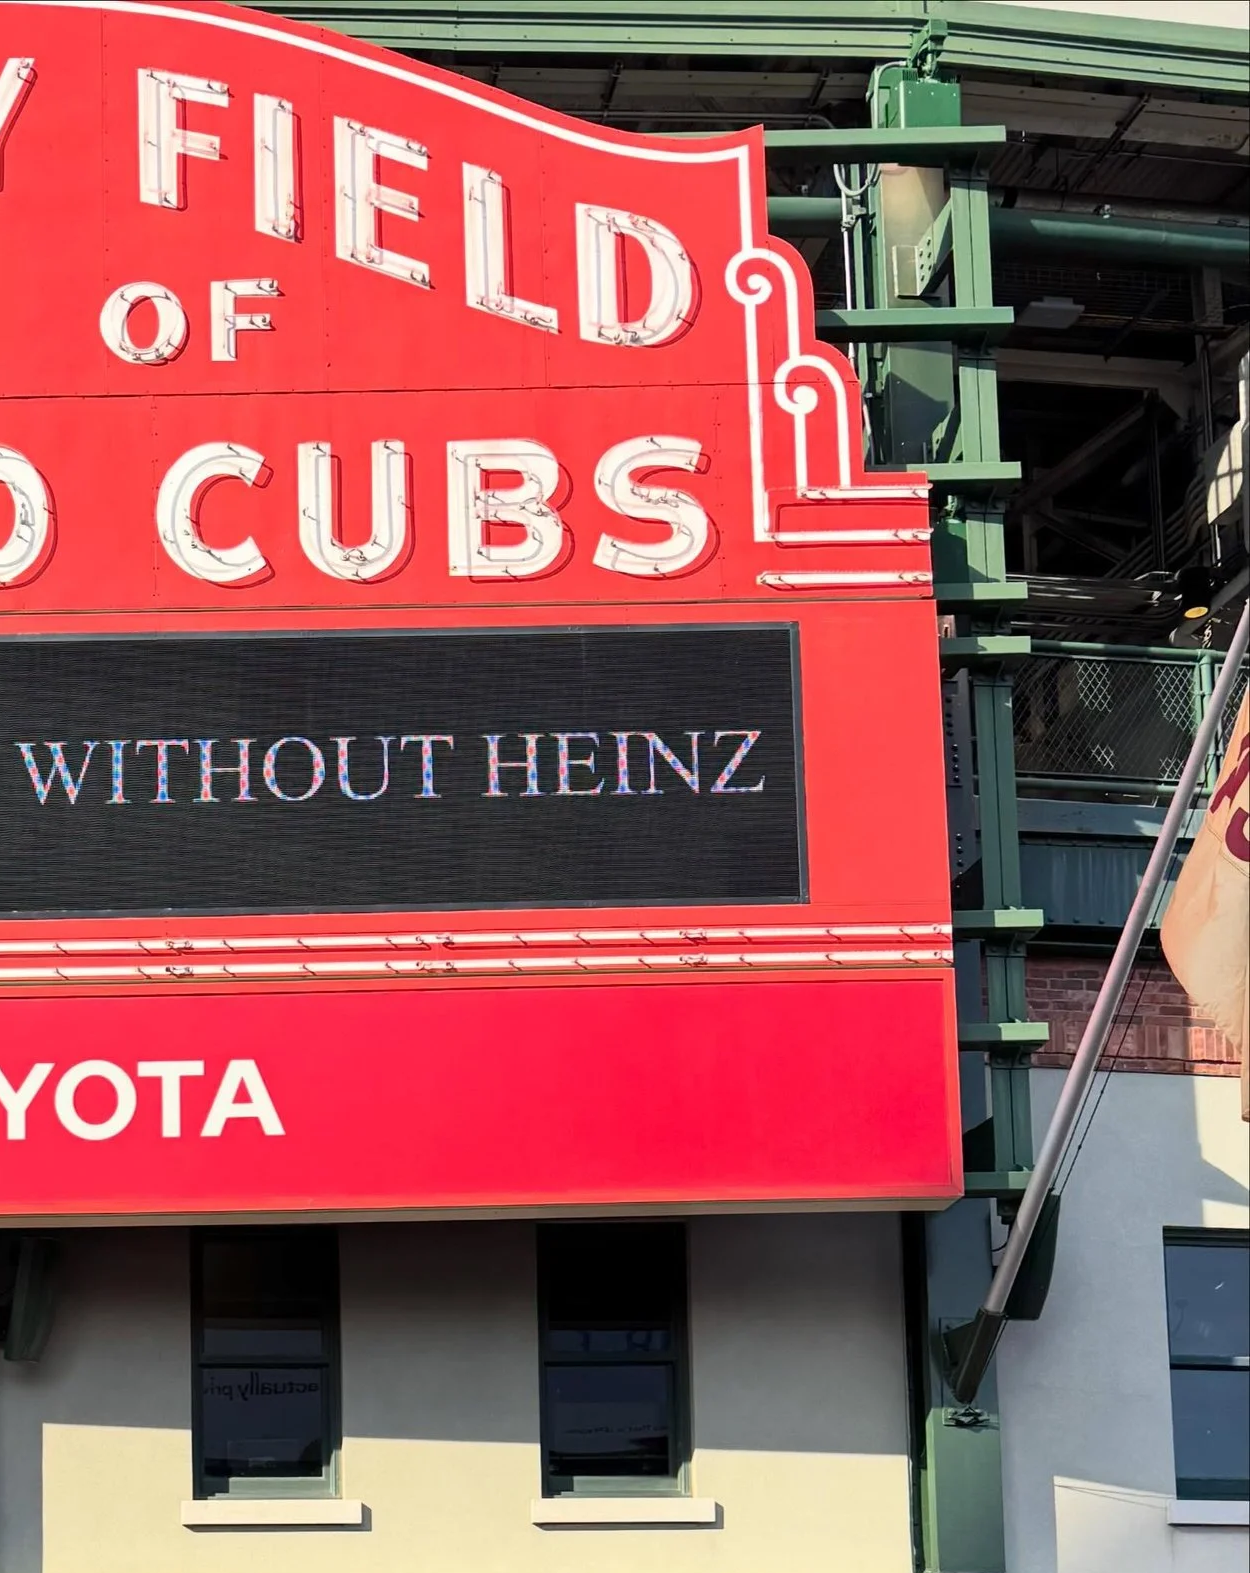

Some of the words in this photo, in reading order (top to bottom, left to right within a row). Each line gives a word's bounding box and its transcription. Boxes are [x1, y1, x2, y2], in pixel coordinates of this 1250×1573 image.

[136, 66, 702, 352] FIELD
[99, 279, 282, 367] OF
[155, 436, 716, 586] CUBS
[18, 734, 454, 805] WITHOUT
[481, 730, 766, 798] HEINZ
